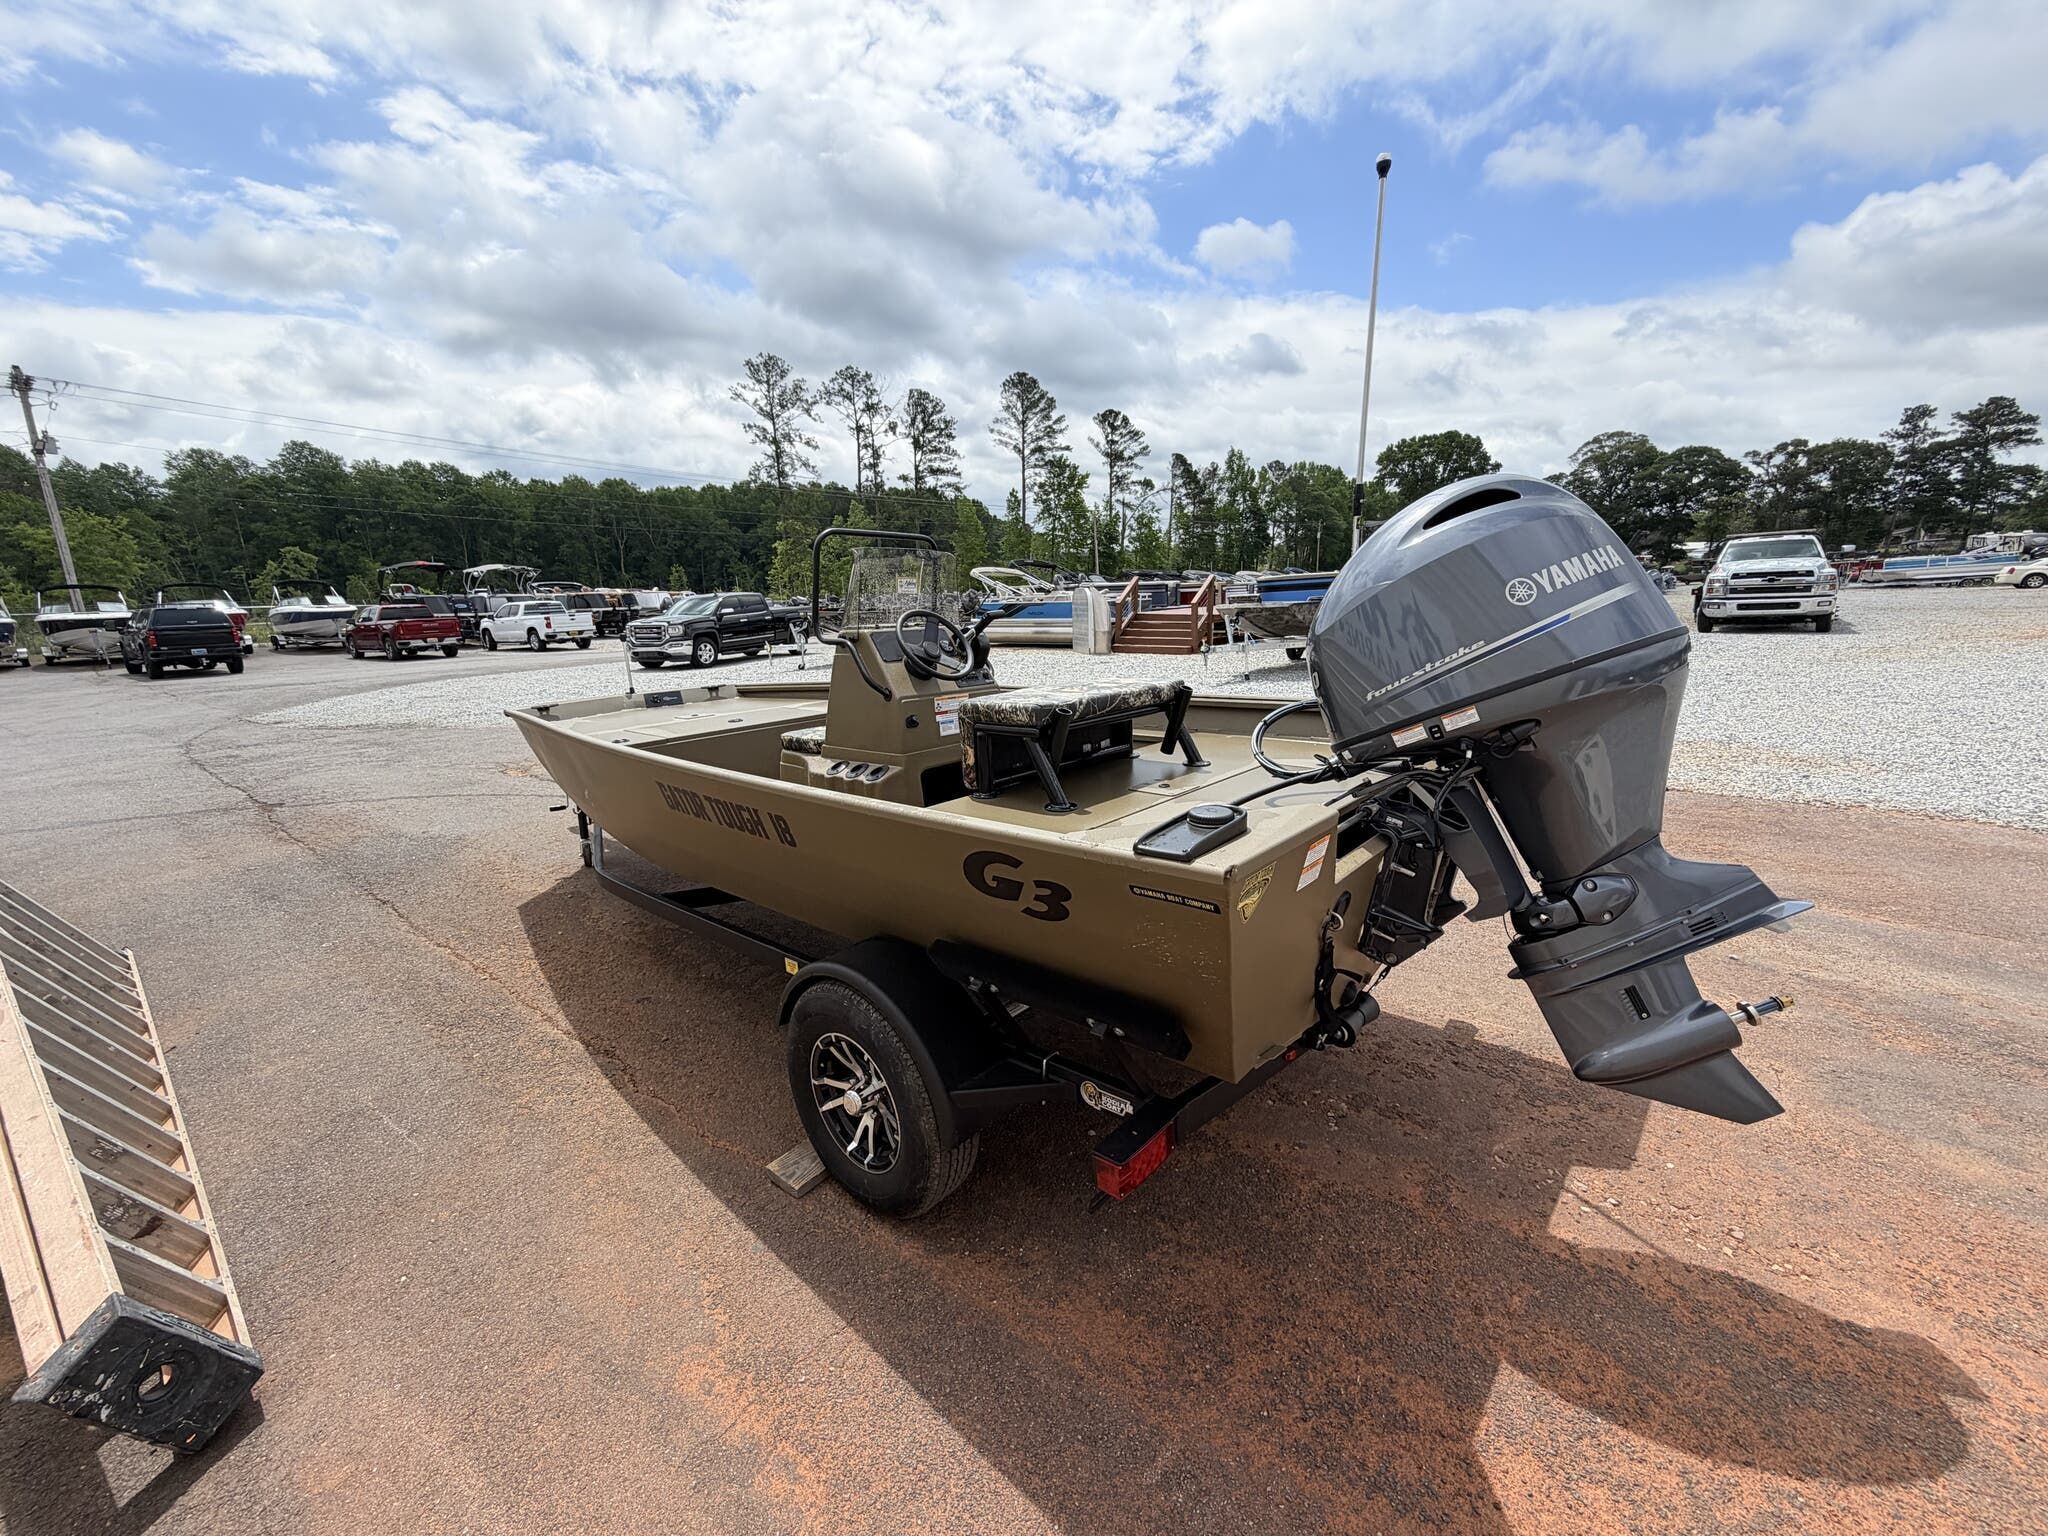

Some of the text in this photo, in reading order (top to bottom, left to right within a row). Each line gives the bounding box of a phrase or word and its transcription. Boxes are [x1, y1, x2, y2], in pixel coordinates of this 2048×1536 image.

[1531, 545, 1625, 594] YAMAHA
[1366, 640, 1487, 701] fourstroke
[655, 780, 797, 848] GATOR TOUGH 18
[963, 850, 1072, 922] G3
